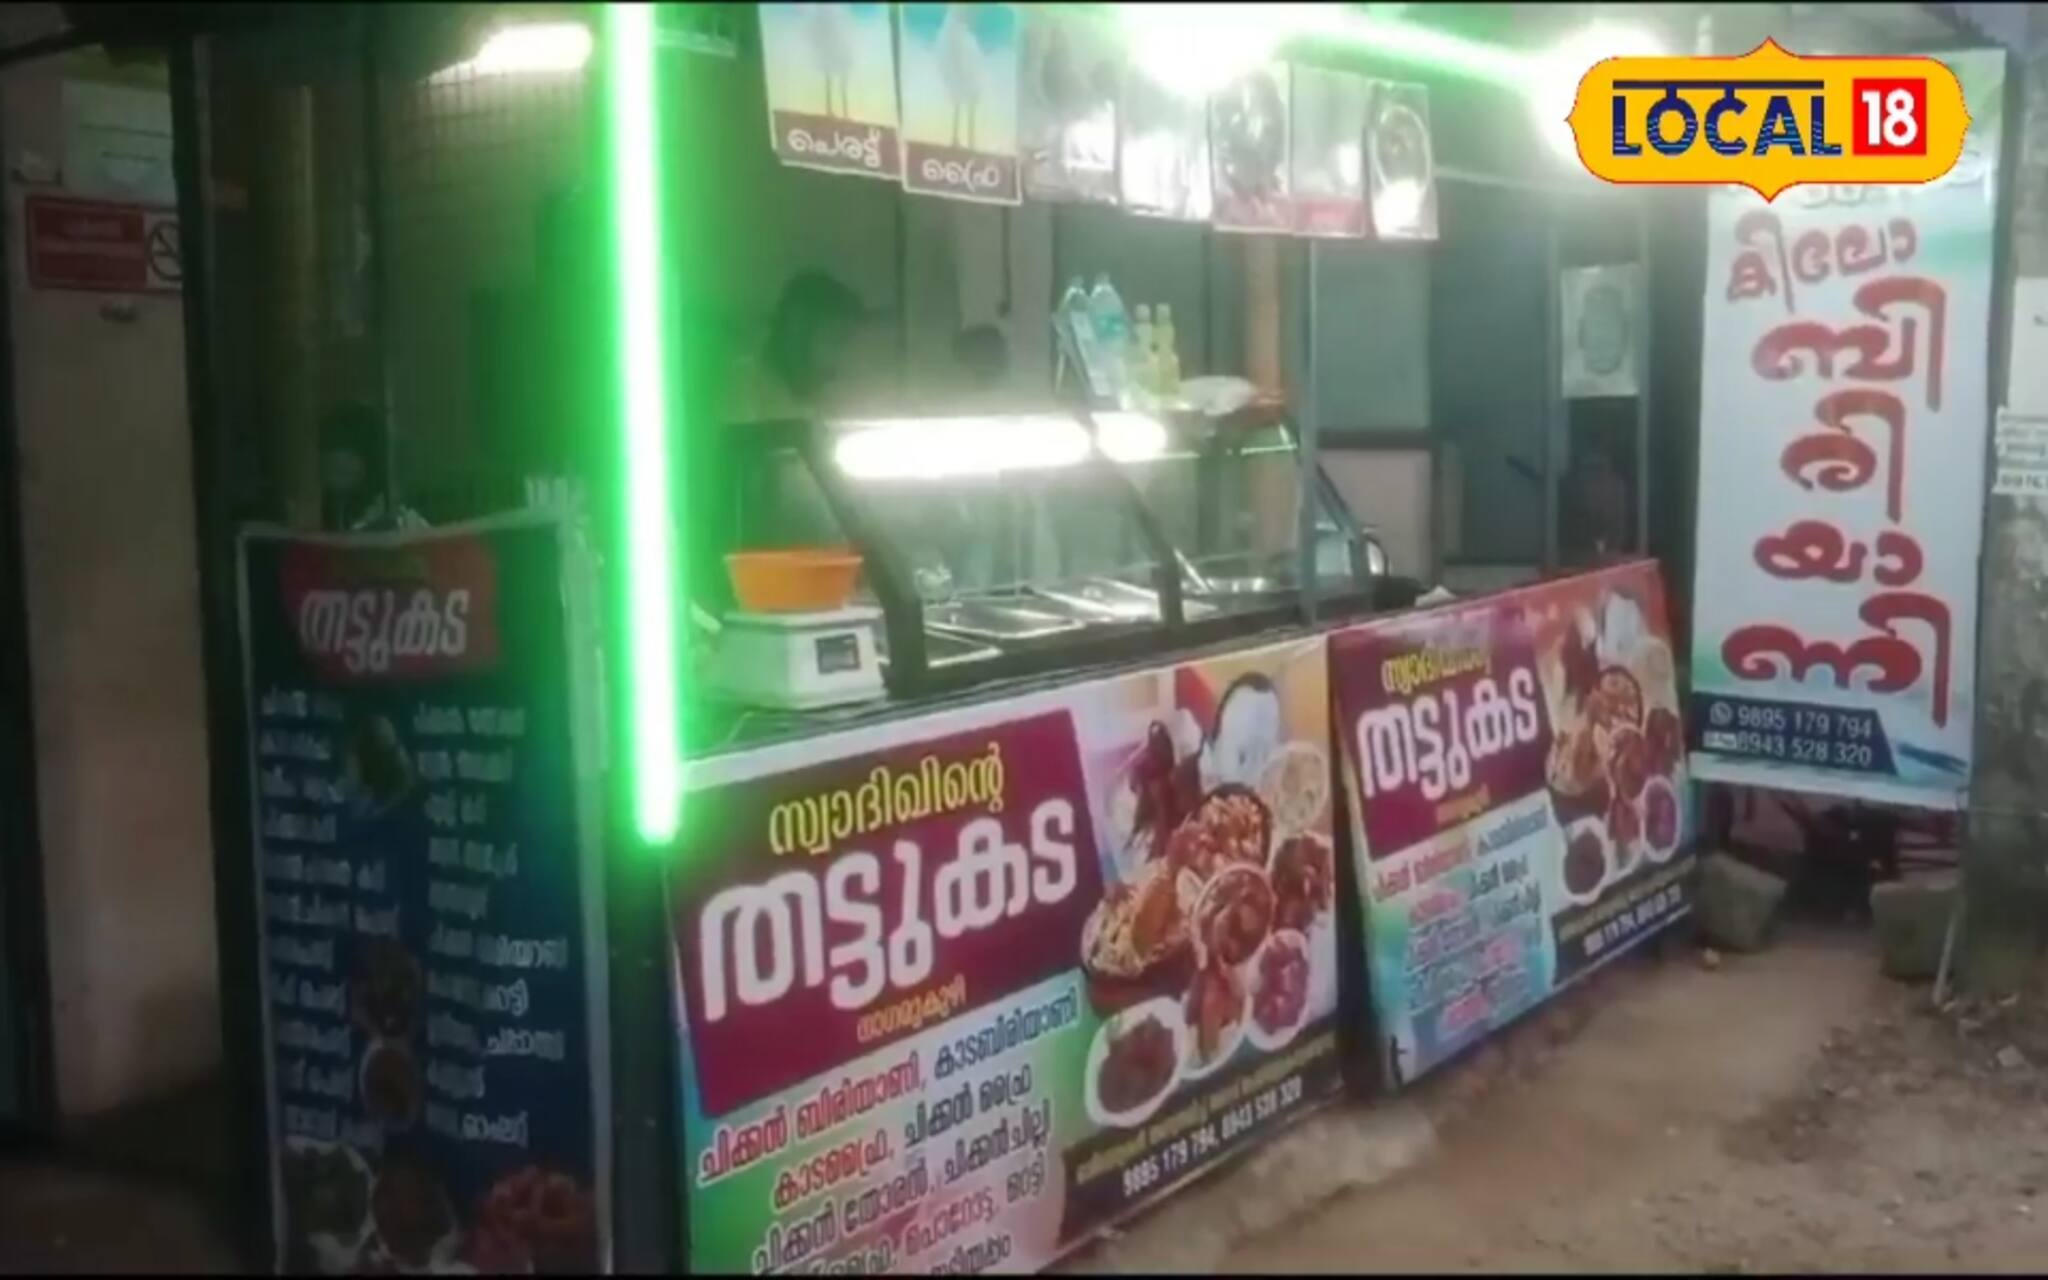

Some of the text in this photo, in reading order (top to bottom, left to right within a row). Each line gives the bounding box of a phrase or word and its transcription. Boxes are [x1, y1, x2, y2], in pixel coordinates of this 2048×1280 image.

[1727, 210, 1917, 313] കിലോ
[302, 590, 471, 672] തട്ടുകട
[1357, 667, 1538, 799] തട്ടുകട
[1736, 731, 1785, 757] 8943
[1791, 736, 1828, 761] 528
[1834, 742, 1872, 767] 320
[1738, 706, 1872, 740] 9895 179 794
[699, 798, 1078, 1021] തട്ടുകട
[701, 1104, 788, 1180] ചിക്കൻ
[905, 1082, 973, 1148] ചിക്കൻ
[1123, 1161, 1160, 1197] 9895
[1162, 1140, 1188, 1172] 179
[755, 1204, 835, 1274] ചിക്കൻ
